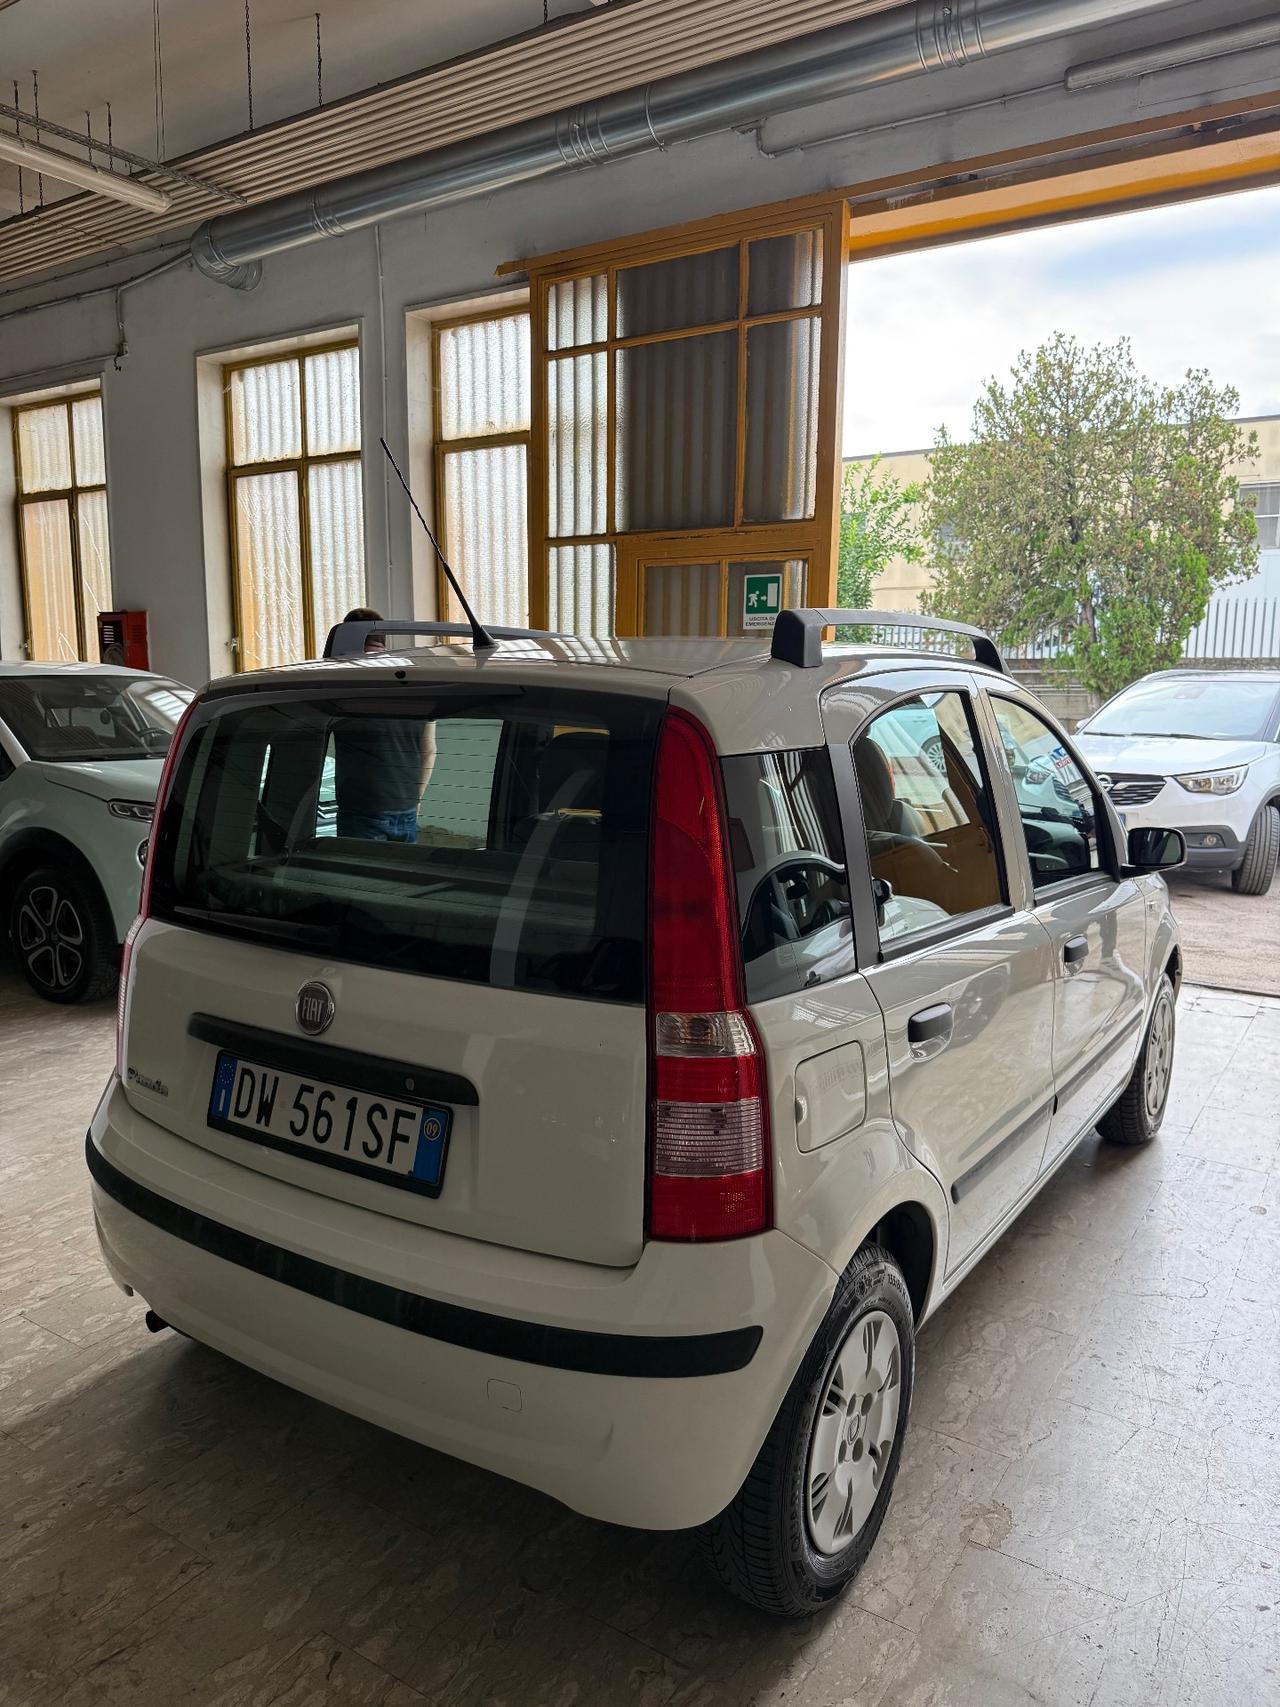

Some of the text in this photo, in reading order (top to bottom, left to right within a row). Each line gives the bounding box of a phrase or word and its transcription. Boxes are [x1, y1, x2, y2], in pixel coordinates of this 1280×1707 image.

[301, 996, 325, 1023] FIAT
[233, 1067, 417, 1165] DW 561SF
[425, 1123, 438, 1137] 09
